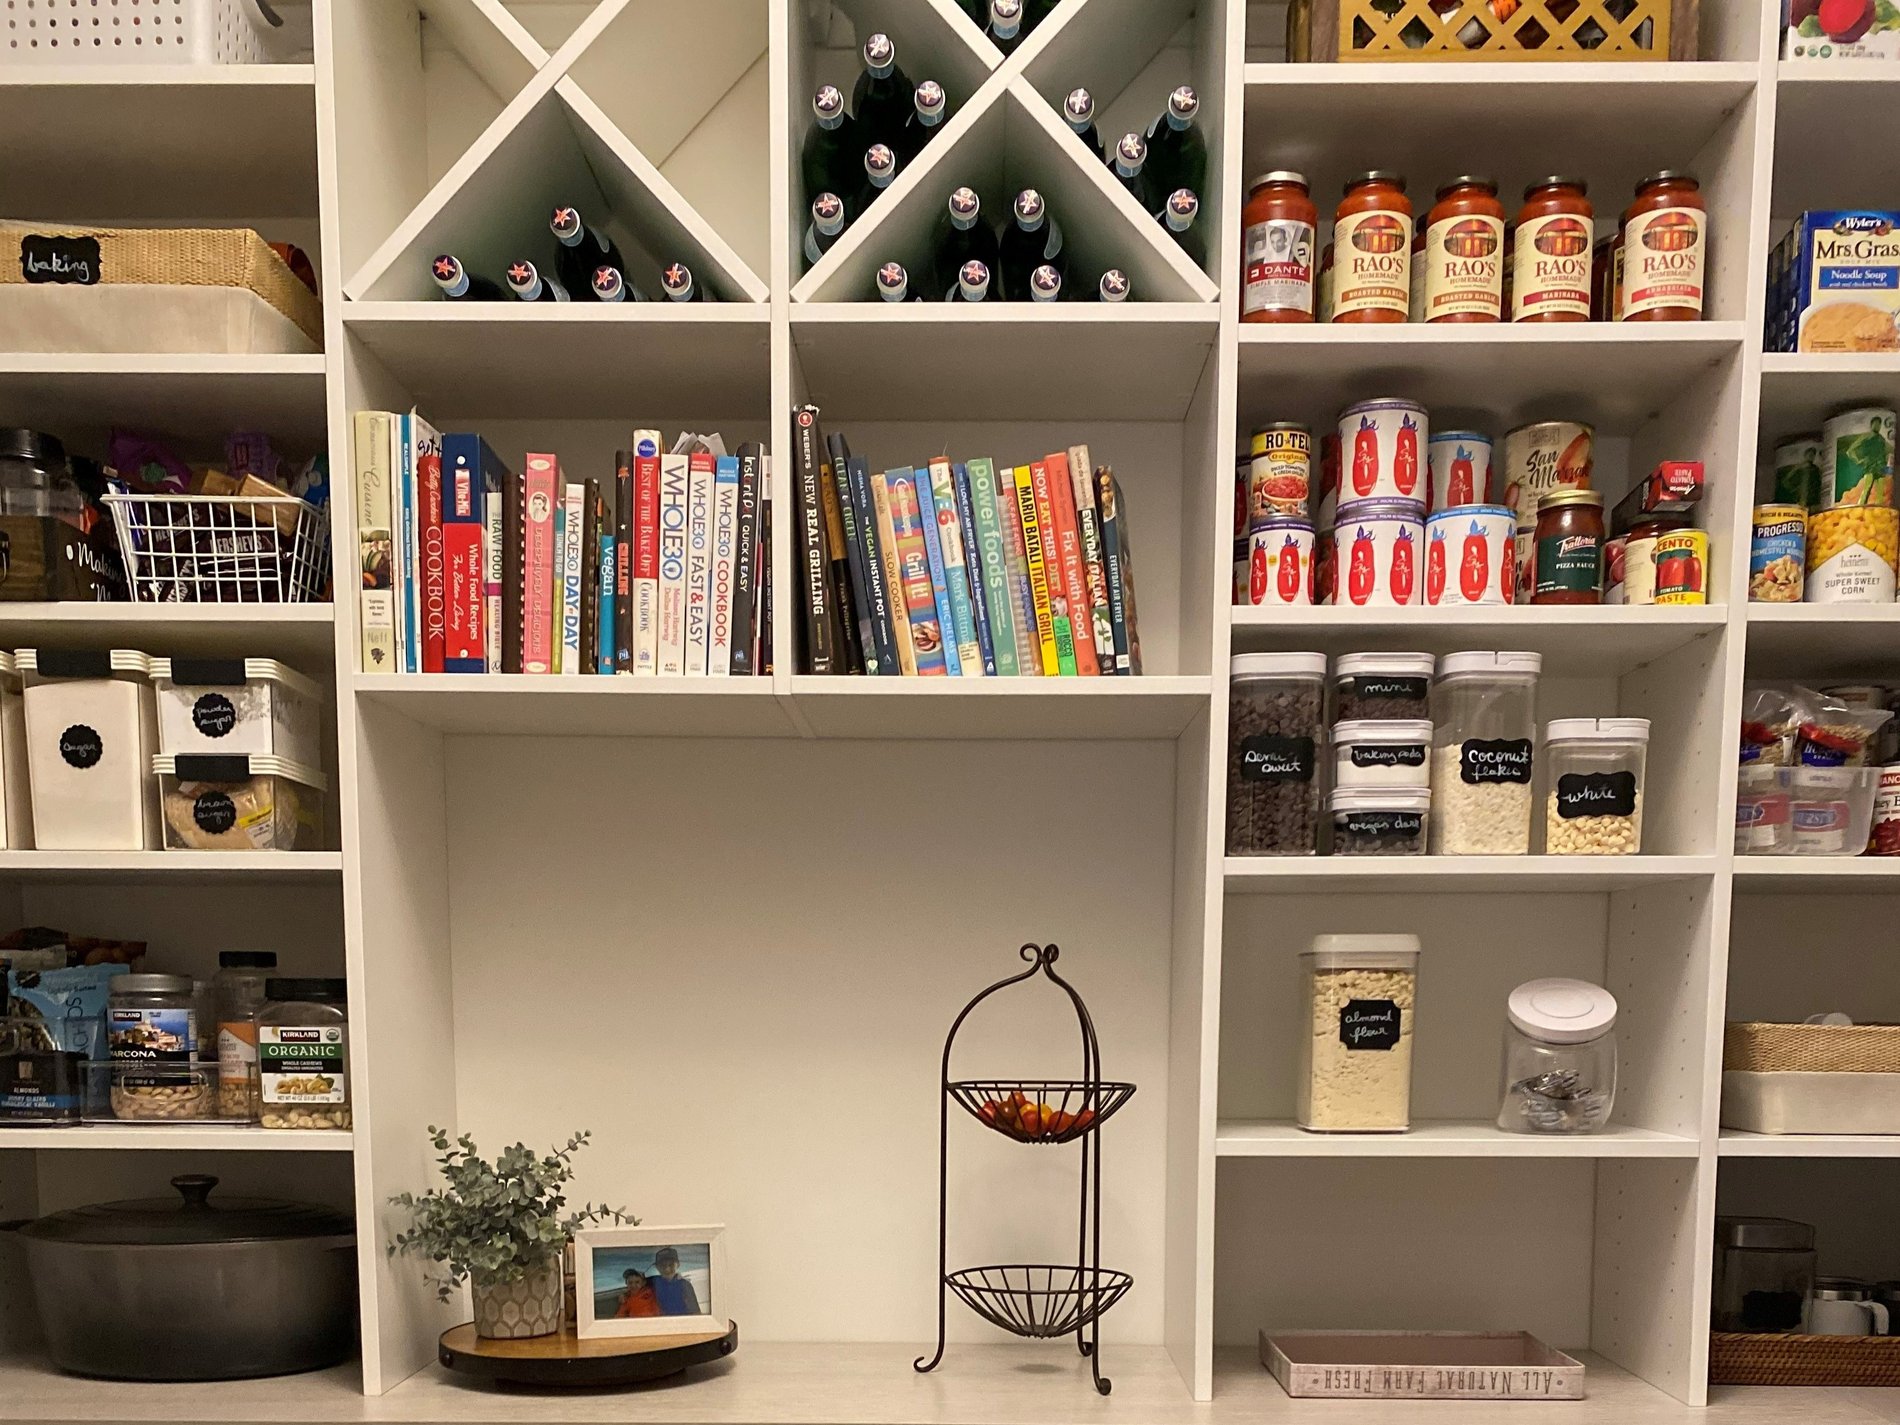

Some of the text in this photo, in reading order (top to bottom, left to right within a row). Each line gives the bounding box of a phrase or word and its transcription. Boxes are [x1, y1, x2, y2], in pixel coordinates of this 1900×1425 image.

[1845, 217, 1882, 229] Wyler's
[1816, 240, 1900, 259] Mrs. Gras
[27, 251, 90, 282] baking
[1264, 265, 1305, 276] DANTE
[1353, 255, 1404, 274] RAO'S
[1444, 260, 1496, 279] RAO'S
[1535, 259, 1586, 278] RAO'S
[1643, 253, 1696, 274] RAO'S
[1831, 269, 1887, 281] Noodle Soup
[1357, 271, 1399, 281] HOMEMADE
[1450, 276, 1492, 285] HOMEMADE
[1540, 275, 1582, 284] HOMEMADE
[1541, 292, 1580, 300] MARINARA
[1526, 449, 1559, 473] San
[1034, 467, 1049, 500] NOW
[362, 466, 381, 526] Cuisine
[662, 465, 684, 580] WHOLE30
[692, 479, 707, 550] WHOLE30
[803, 429, 824, 616] WEBER'S NEW REAL GRILLING
[965, 517, 973, 528] AIR
[1039, 501, 1052, 526] EAT
[971, 464, 994, 528] power
[983, 529, 1005, 589] foods
[1757, 521, 1804, 538] PROGRESSO
[492, 519, 503, 580] RAW FOOD
[640, 463, 654, 632] BEST OF THE COOKBOOK
[742, 525, 750, 555] QUICK
[864, 525, 876, 559] VEGAN
[1657, 538, 1694, 552] CENTO
[714, 489, 733, 647] WHOLE30 COOKBOOK
[905, 552, 926, 580] Grill
[1019, 486, 1054, 645] MARIO BATALI ITALIAN GRILL
[1081, 509, 1104, 608] EVERYDAY ITALIAN
[1577, 561, 1595, 569] SAUCE
[426, 526, 444, 640] COOKBOOK
[602, 546, 615, 597] vegan
[740, 565, 749, 593] EASY
[869, 560, 882, 597] INSTANT
[1049, 563, 1062, 592] DIET
[1825, 577, 1880, 588] SUPER SWEET
[467, 543, 480, 640] Whole Food Recipes
[885, 551, 903, 622] SLOW COOKER
[950, 571, 964, 602] Mark
[1061, 531, 1090, 641] Fix It with Food
[1109, 554, 1123, 623] EVERYDAY AIR FRYER
[1660, 586, 1684, 594] TOMATO
[1841, 586, 1865, 595] CORN
[875, 598, 886, 616] POT
[941, 599, 951, 620] ERIC
[1656, 594, 1687, 604] PASTE
[1354, 748, 1397, 764] baking
[1562, 785, 1616, 804] white
[1344, 1009, 1394, 1024] almond
[268, 1045, 335, 1056] ORGANIC
[1324, 1369, 1554, 1395] ALL NATURAL FARM FRESH
